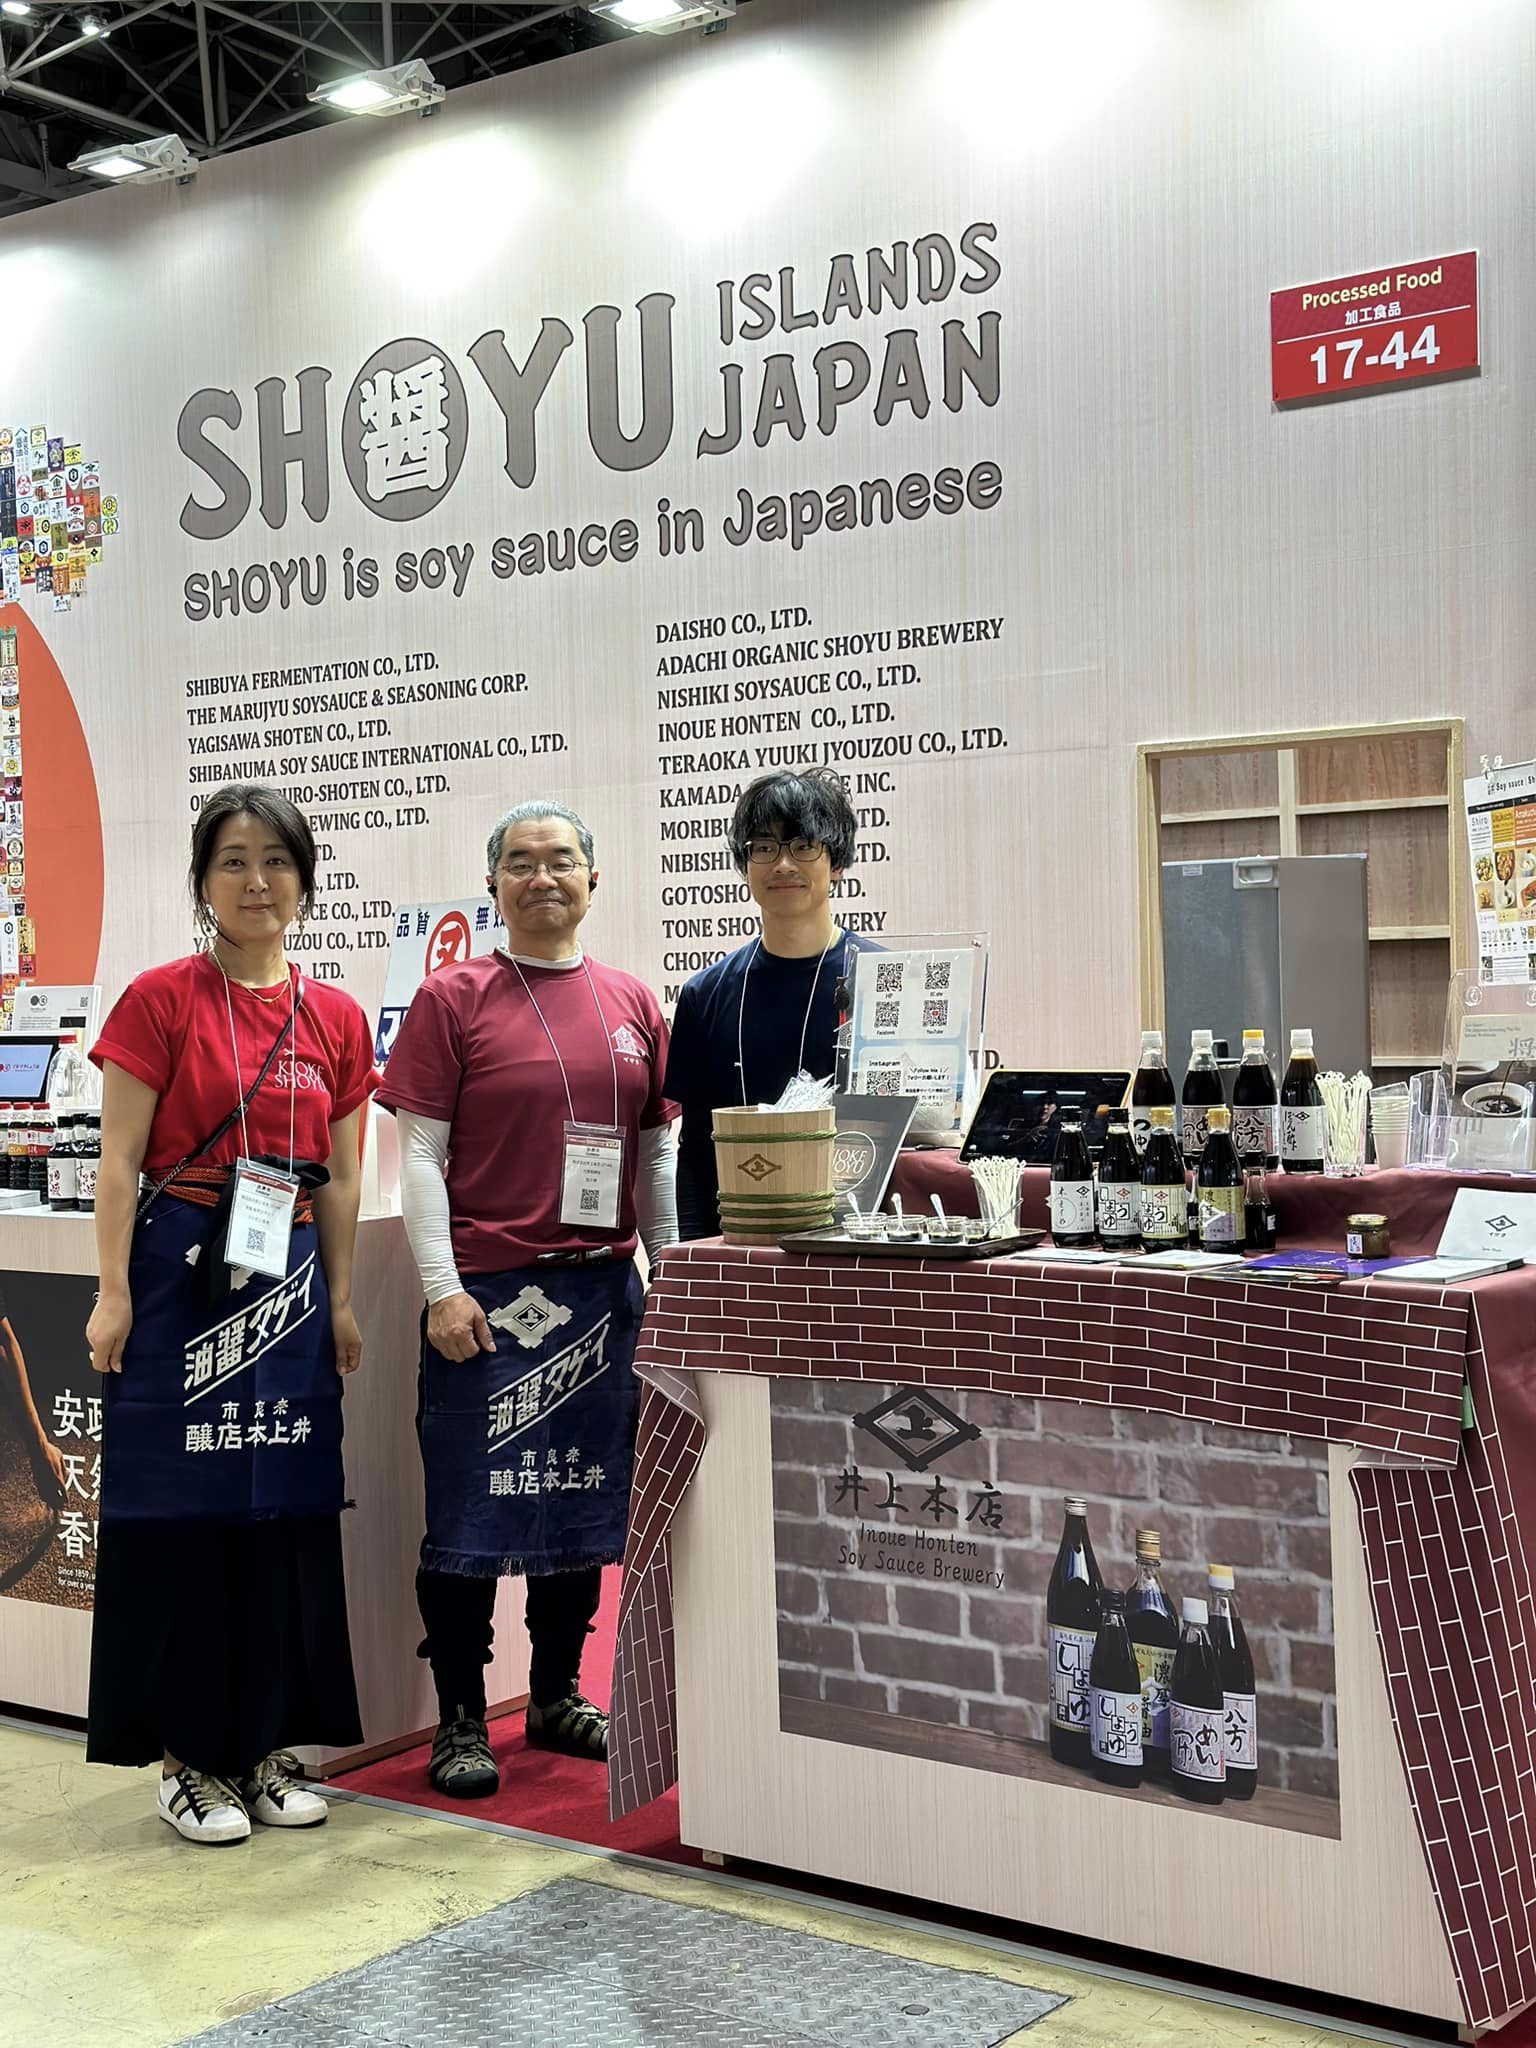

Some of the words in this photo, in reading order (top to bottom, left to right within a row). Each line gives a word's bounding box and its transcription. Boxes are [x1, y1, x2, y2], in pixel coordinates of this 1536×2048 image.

[716, 222, 1001, 345] ISLANDS
[1302, 276, 1390, 310] Processed
[1396, 266, 1442, 292] Food
[1345, 302, 1401, 325] 加工食品
[1310, 325, 1441, 385] 17-44
[697, 311, 1002, 460] JAPAN
[184, 563, 326, 623] SHOYU
[344, 548, 379, 602] is
[395, 541, 475, 598] soy
[491, 517, 639, 581] sauce
[658, 498, 704, 556] in
[723, 461, 1003, 551] Japanese
[656, 617, 726, 643] DAISHO
[731, 614, 766, 633] CO.,
[770, 607, 812, 629] LTD.
[656, 649, 727, 677] ADACHI
[732, 640, 818, 668] ORGANIC
[823, 632, 892, 659] SHOYU
[897, 618, 1004, 650] BREWERY
[186, 674, 249, 697] SHIBUYA
[252, 660, 369, 691] FERMENTATION
[373, 656, 401, 676] CO.,
[405, 652, 439, 672] LTD.
[657, 683, 730, 710] NISHIKI
[734, 673, 831, 702] SOYSAUCE
[835, 670, 872, 692] CO.,
[876, 664, 921, 687] LTD.
[187, 706, 217, 726] THE
[220, 699, 288, 724] MARUJYU
[292, 690, 367, 716] SOYSAUCE
[371, 689, 384, 706] &
[387, 679, 477, 705] SEASONING
[481, 673, 528, 696] CORP.
[188, 732, 261, 754] YAGISAWA
[264, 725, 323, 748] SHOTEN
[327, 722, 354, 743] CO.,
[358, 719, 391, 739] LTD.
[658, 718, 716, 743] INOUE
[720, 711, 801, 737] HONTEN
[810, 707, 846, 729] CO.,
[851, 702, 895, 725] LTD.
[189, 756, 277, 784] SHIBANUMA
[280, 756, 308, 776] SOY
[311, 750, 358, 774] SAUCE
[362, 739, 493, 770] INTERNATIONAL
[497, 737, 527, 758] CO.,
[531, 733, 568, 753] LTD.
[659, 750, 751, 776] TERAOKA
[754, 744, 818, 768] YUUKI
[822, 735, 913, 767] JYOUZOU
[918, 731, 956, 754] CO.,
[961, 727, 1008, 751] LTD.
[280, 780, 379, 804] URO-SHOTEN
[384, 778, 412, 798] CO.,
[416, 774, 450, 794] LTD.
[659, 783, 742, 809] KAMADA
[856, 771, 896, 794] INC.
[309, 812, 360, 832] EWING
[364, 810, 392, 830] CO.,
[396, 807, 429, 827] LTD.
[660, 819, 733, 841] MORIBU
[859, 808, 890, 828] TD.
[314, 844, 336, 861] TD.
[327, 872, 358, 890] LTD.
[662, 883, 751, 906] GOTOSHO
[332, 902, 358, 921] CO.,
[362, 900, 395, 918] LTD.
[663, 918, 713, 938] TONE
[283, 933, 321, 951] UZOU
[327, 932, 353, 951] CO.,
[357, 931, 390, 948] LTD.
[312, 962, 344, 979] LTD.
[970, 1049, 1004, 1069] TD.
[834, 1465, 1003, 1529] 井上本店
[860, 1522, 907, 1547] Inoue
[915, 1530, 978, 1557] Honten
[837, 1545, 866, 1570] Soy
[874, 1550, 925, 1575] Sauce
[933, 1558, 1005, 1589] Brewery
[1224, 1708, 1248, 1753] 八方
